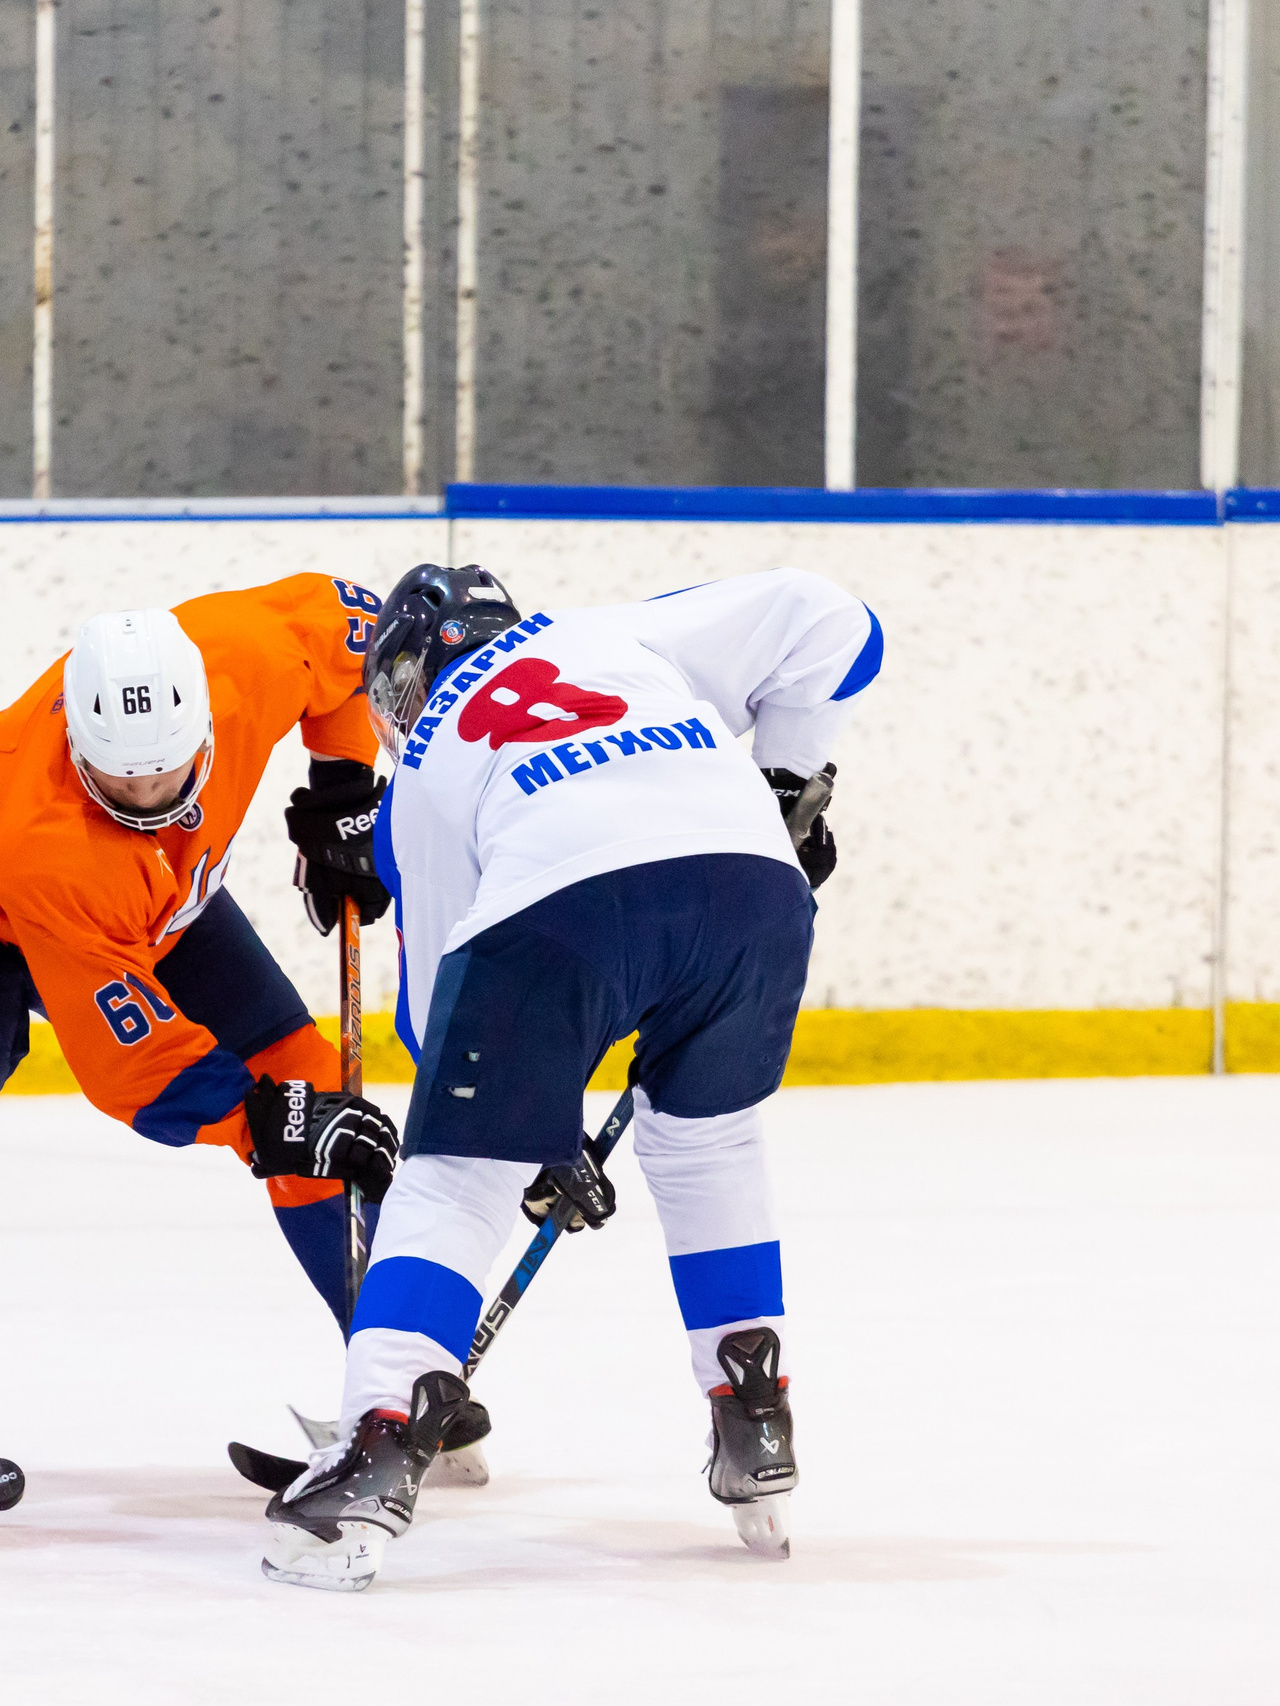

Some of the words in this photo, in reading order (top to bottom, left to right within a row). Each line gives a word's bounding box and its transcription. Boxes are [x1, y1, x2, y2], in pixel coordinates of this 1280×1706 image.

[122, 685, 152, 715] 66
[402, 612, 554, 770] КАЗАРИН
[457, 657, 629, 752] 8
[511, 717, 718, 796] МЕГИОН
[335, 800, 382, 841] Ree
[771, 788, 801, 797] CM
[283, 1079, 307, 1142] Reebo
[587, 1190, 605, 1213] CCM
[462, 1296, 515, 1383] XUS
